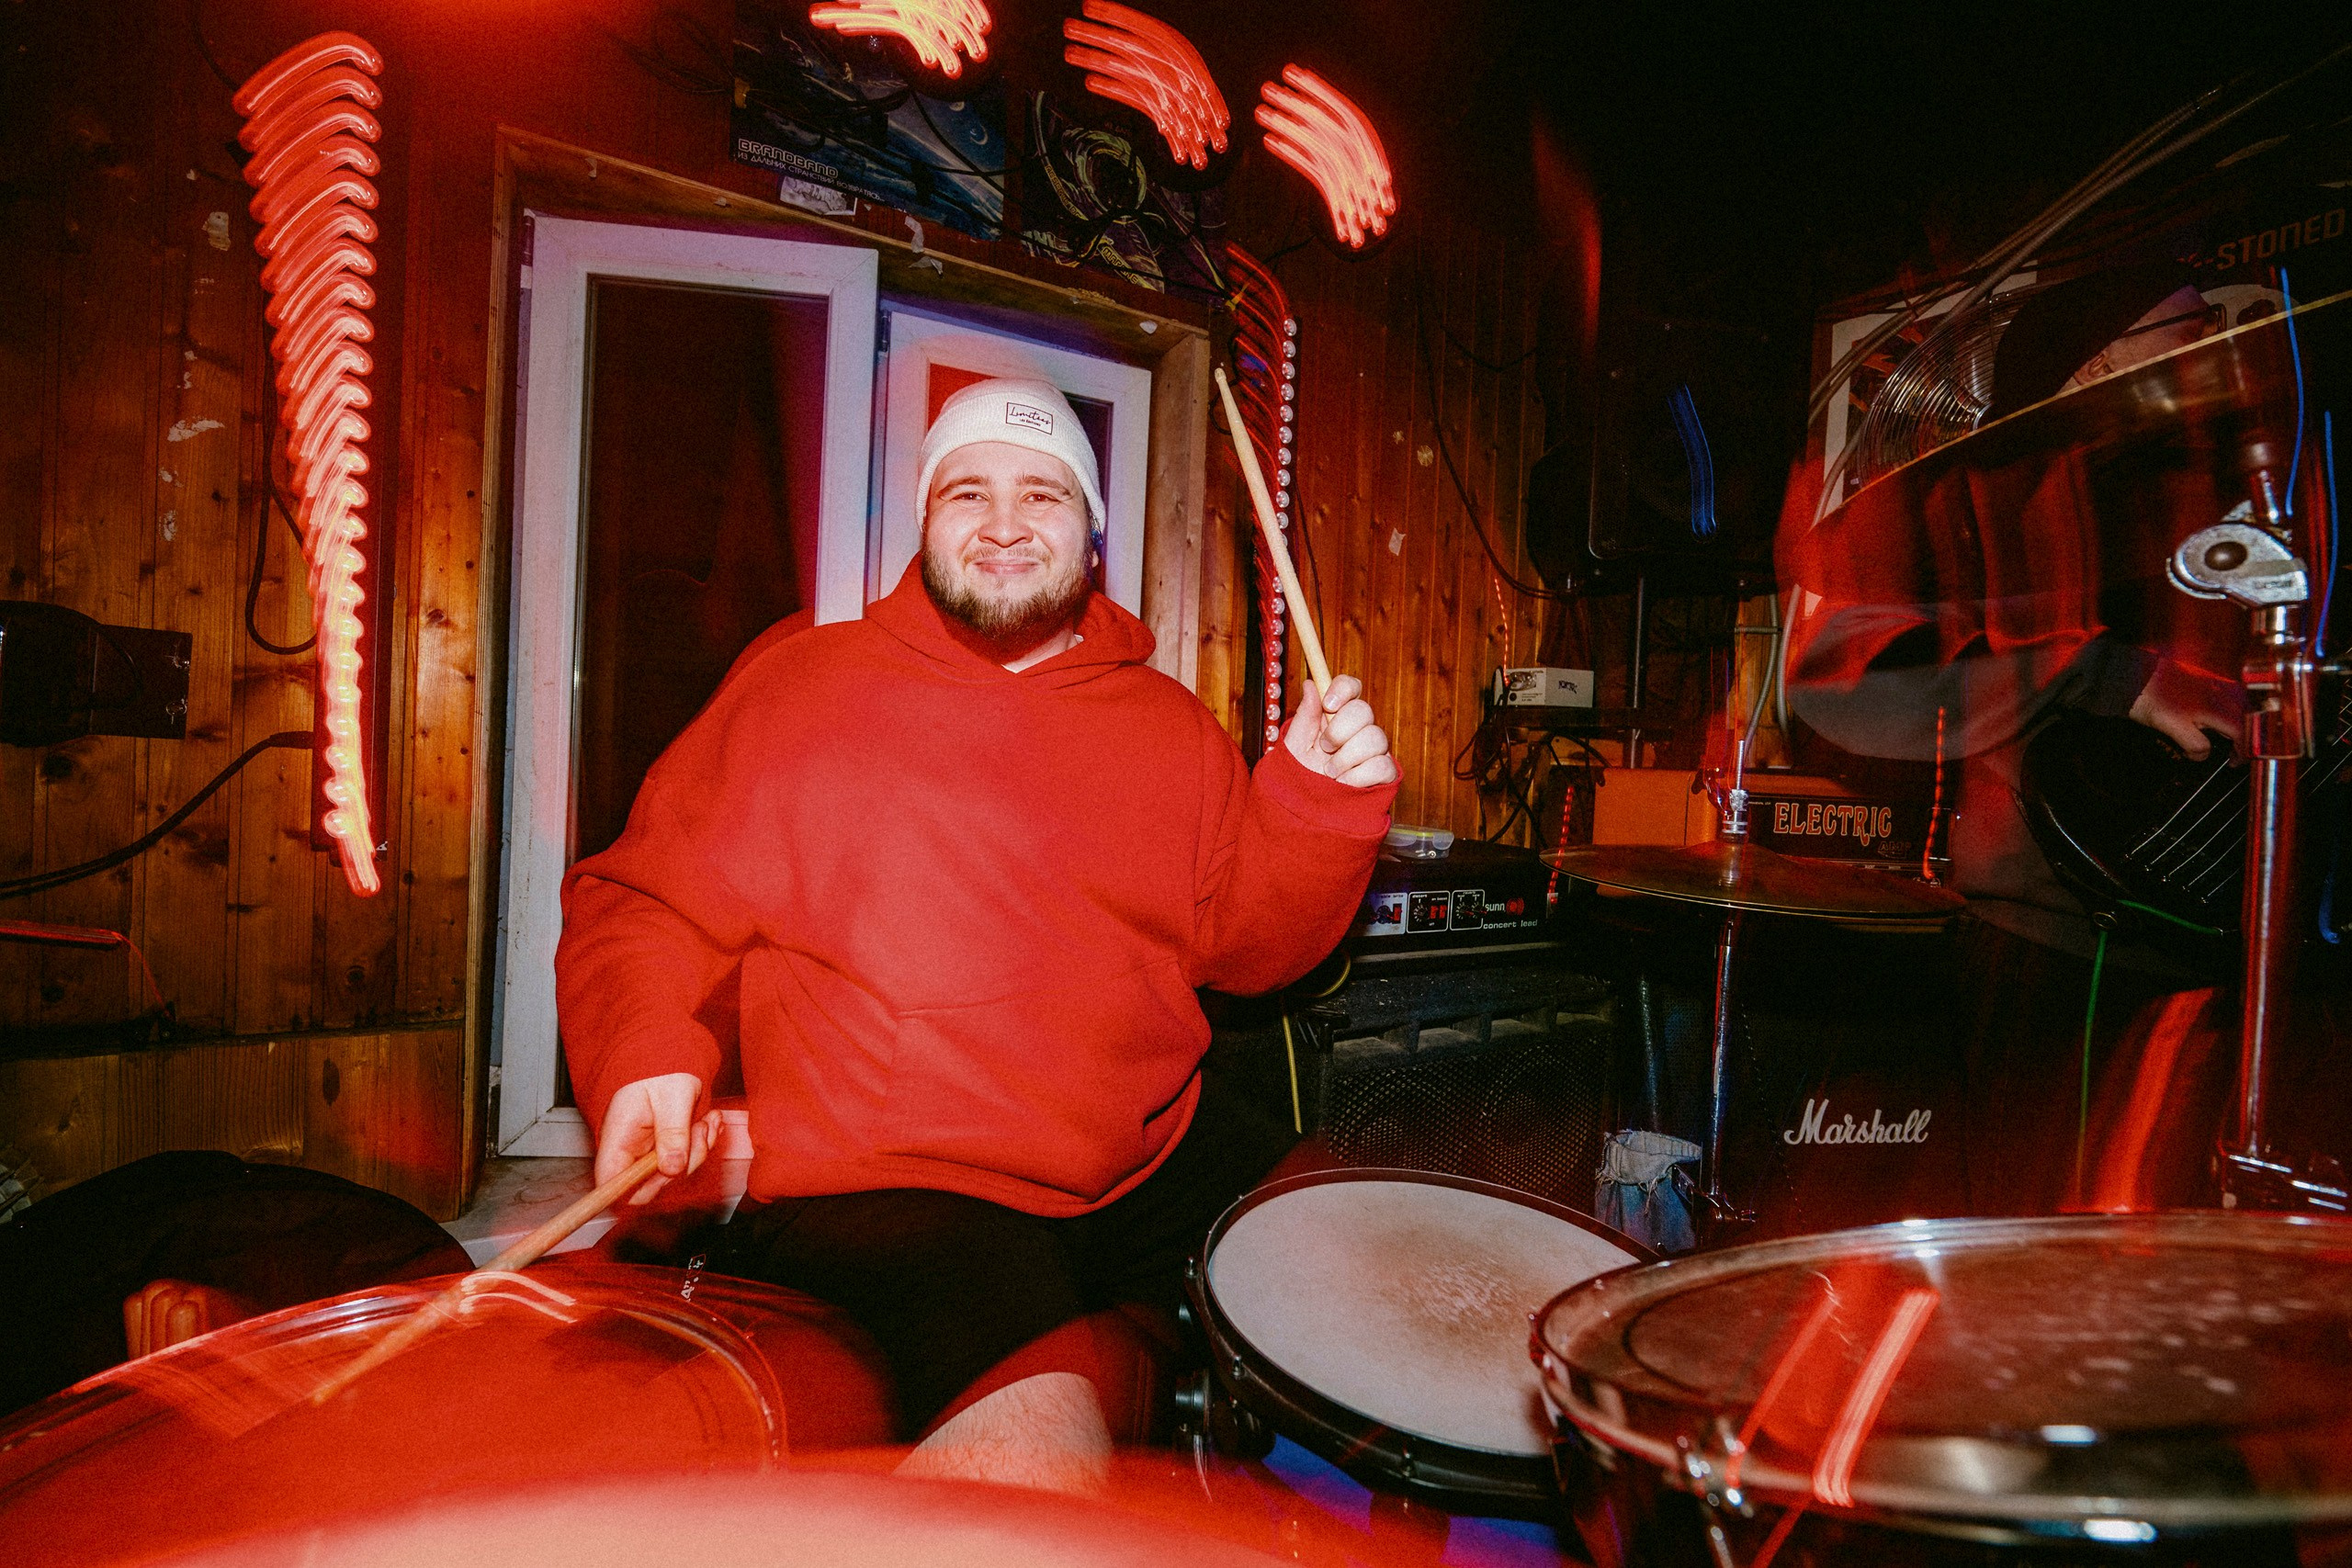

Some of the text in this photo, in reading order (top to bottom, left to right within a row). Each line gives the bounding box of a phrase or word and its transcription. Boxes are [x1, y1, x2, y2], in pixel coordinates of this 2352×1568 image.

[738, 139, 839, 178] BRANDBAND
[738, 152, 748, 161] ИЗ
[751, 155, 786, 170] ДАЛЬНИХ
[788, 166, 835, 184] СТРАНСТВИЙ
[1773, 803, 1893, 847] ELECTRIC
[1483, 919, 1538, 930] concert lead
[1485, 903, 1505, 912] sunn
[1783, 1099, 1932, 1145] Marshall
